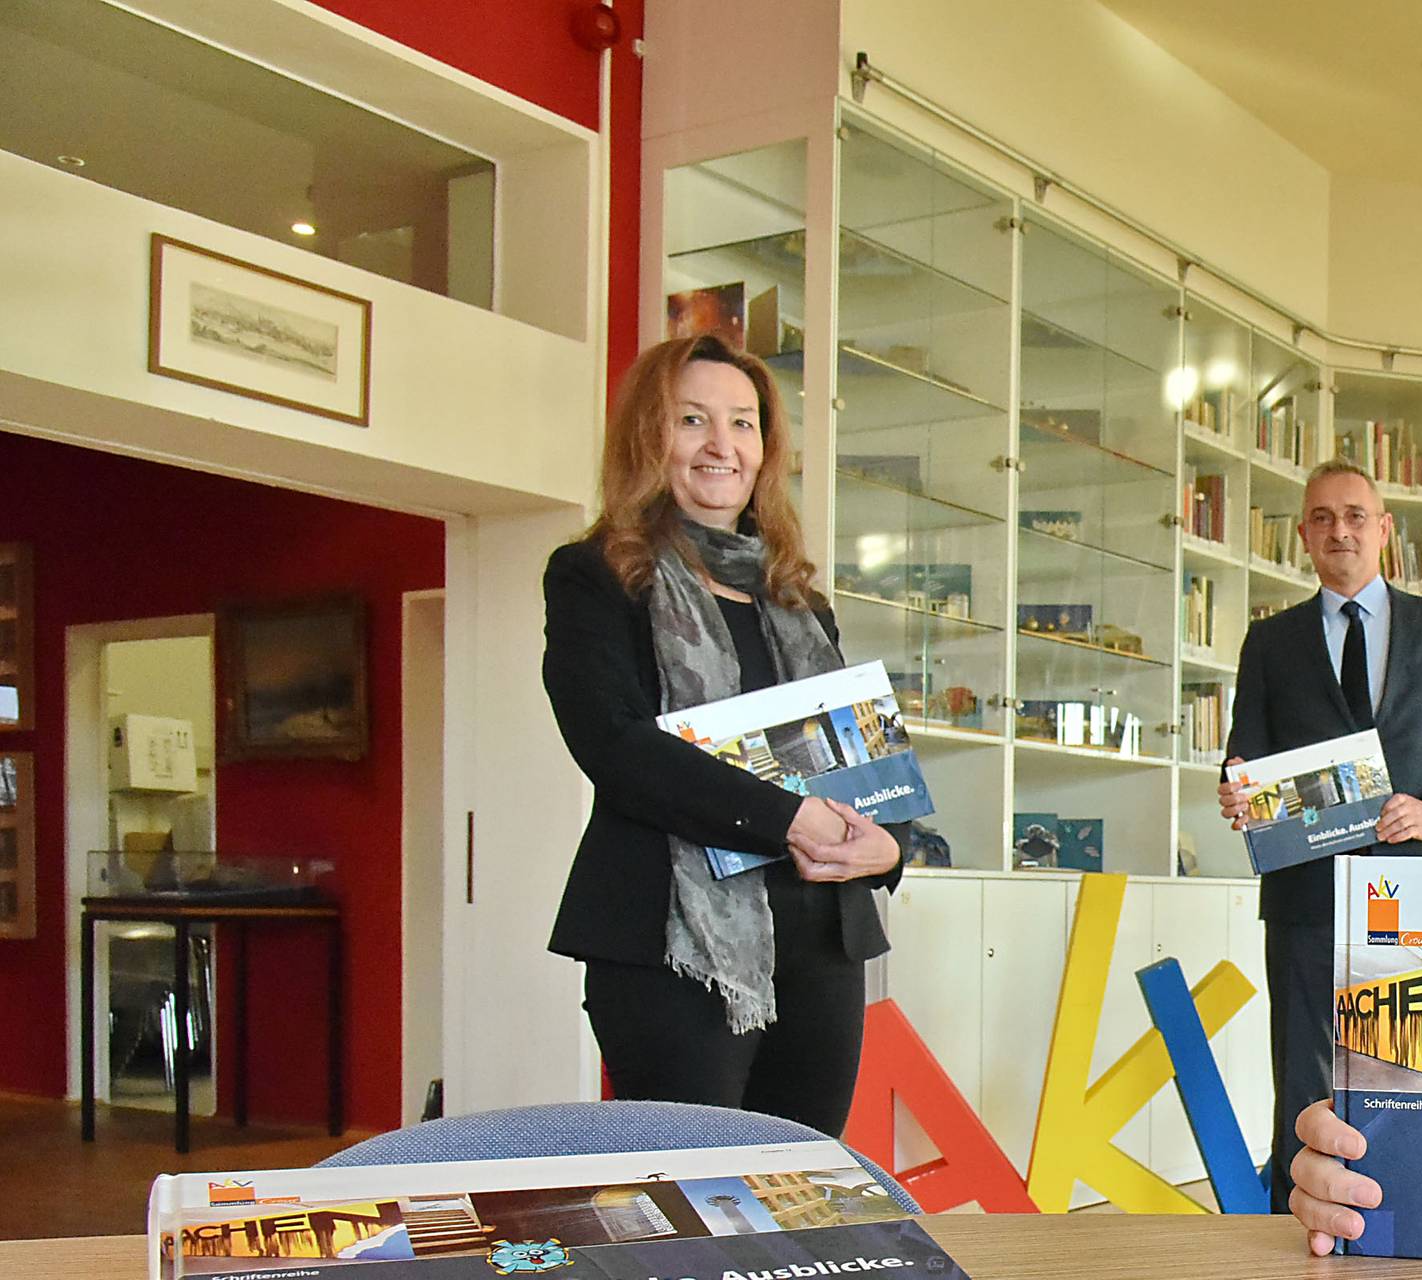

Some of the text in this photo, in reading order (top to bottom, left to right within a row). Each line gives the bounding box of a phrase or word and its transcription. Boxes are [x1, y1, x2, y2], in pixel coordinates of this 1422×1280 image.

[854, 784, 915, 809] Ausblicke.
[1368, 934, 1398, 945] Sammlung
[721, 1256, 915, 1280] Ausblicke.
